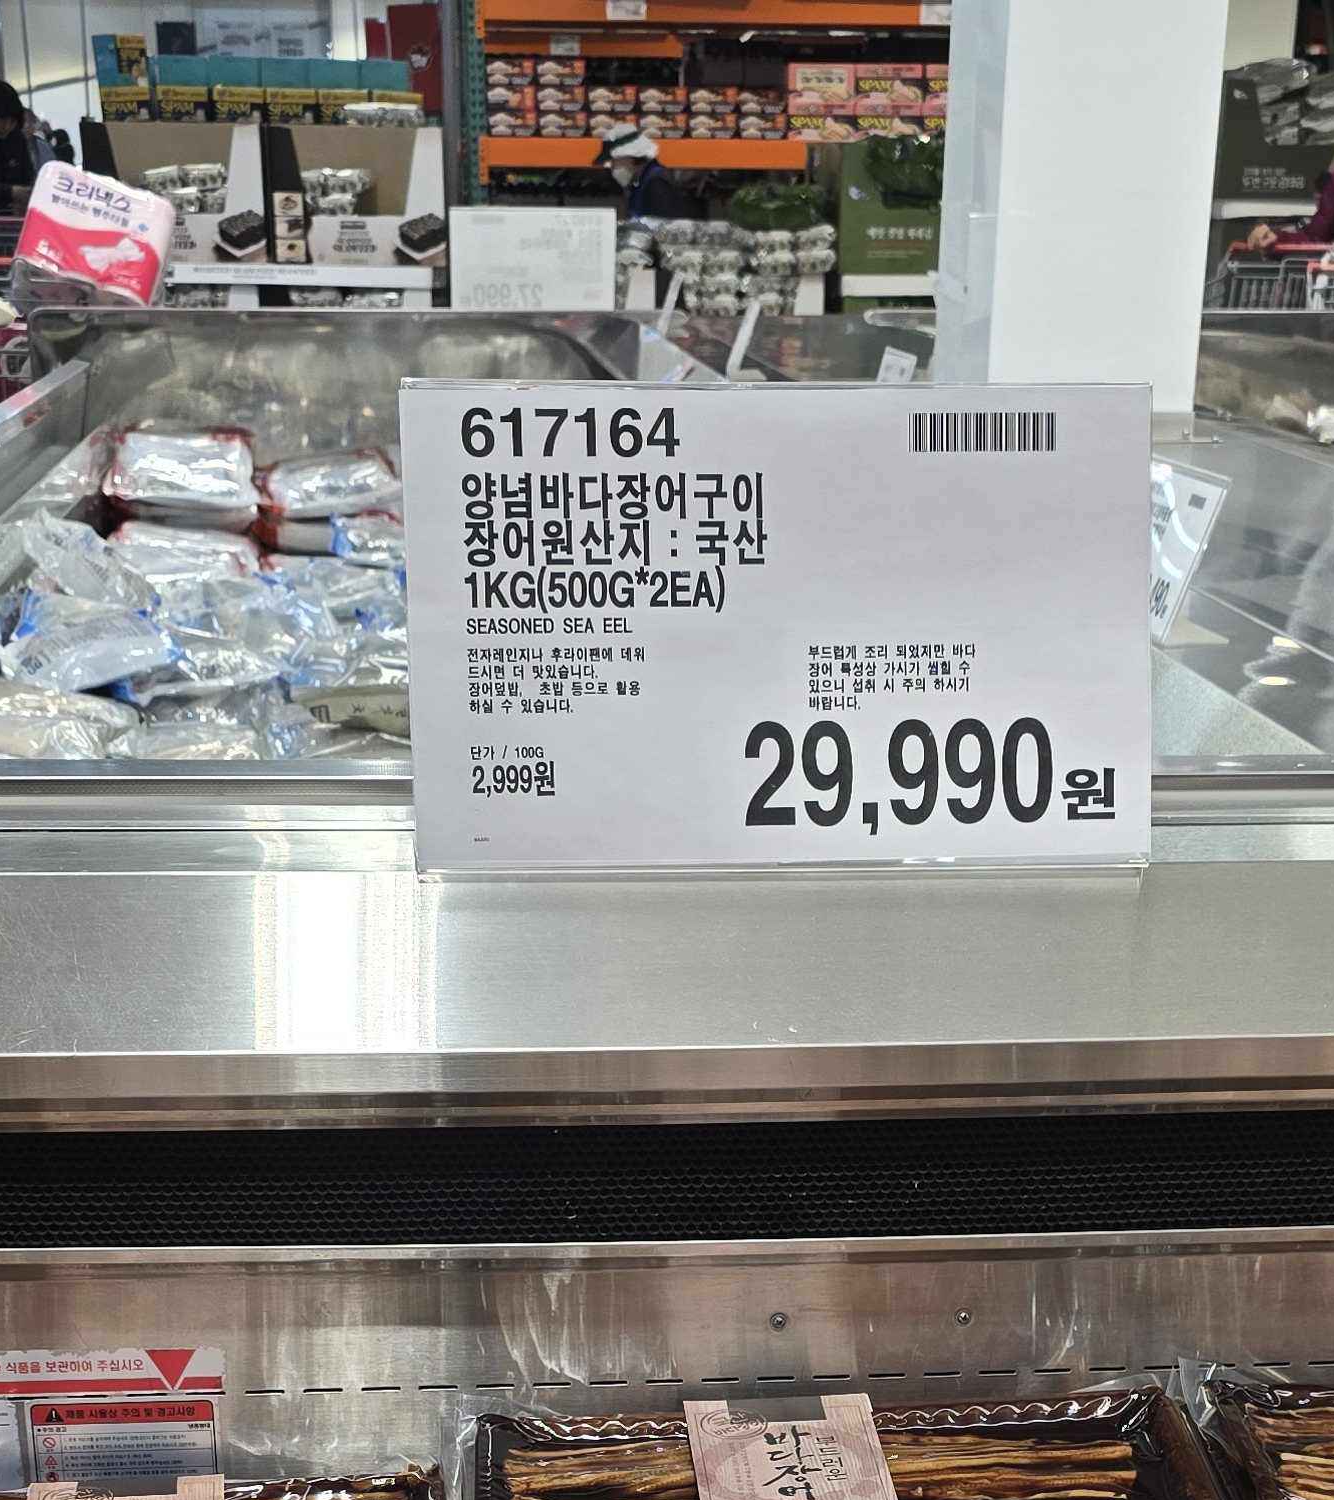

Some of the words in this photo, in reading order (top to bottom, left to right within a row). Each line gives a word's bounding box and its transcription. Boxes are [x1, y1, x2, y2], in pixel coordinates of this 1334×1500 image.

[53, 172, 131, 213] 크리넥스
[462, 408, 680, 457] 617164
[462, 472, 762, 520] 양념바다장어구이
[464, 521, 650, 567] 장어원산지
[696, 521, 767, 567] 국산
[467, 618, 554, 634] SEASONED
[563, 618, 594, 634] SEA
[603, 618, 633, 633] EEL
[467, 648, 543, 663] 전자레인지나
[551, 647, 612, 662] 후라이팬에
[621, 647, 644, 662] 데워
[809, 645, 856, 660] 부드럽게
[865, 645, 887, 659] 조리
[896, 644, 944, 659] 되었지만
[953, 644, 975, 658] 바다
[468, 665, 504, 680] 드시면
[513, 665, 524, 680] 더
[532, 664, 598, 679] 맛있습니다.
[809, 662, 832, 677] 장어
[884, 661, 919, 676] 가시가
[959, 661, 970, 675] 수
[539, 682, 563, 696] 초밥
[572, 682, 608, 696] 등으로
[616, 681, 640, 696] 활용
[809, 679, 844, 693] 있으니
[853, 679, 875, 693] 섭취
[884, 678, 894, 693] 시
[903, 678, 925, 692] 주의
[934, 677, 969, 692] 하시기
[469, 699, 492, 714] 하실
[501, 699, 512, 714] 수
[521, 699, 573, 713] 있습니다.
[809, 696, 860, 711] 바랍니다.
[471, 746, 494, 760] 단가
[502, 745, 507, 759] /
[515, 747, 544, 758] 100G
[473, 761, 555, 798] 2,999원
[745, 717, 1115, 835] 29,990원
[6, 1361, 41, 1374] 식품을
[45, 1360, 93, 1373] 보관하여
[97, 1359, 144, 1372] 주십시오
[764, 1425, 822, 1500] 바다장어
